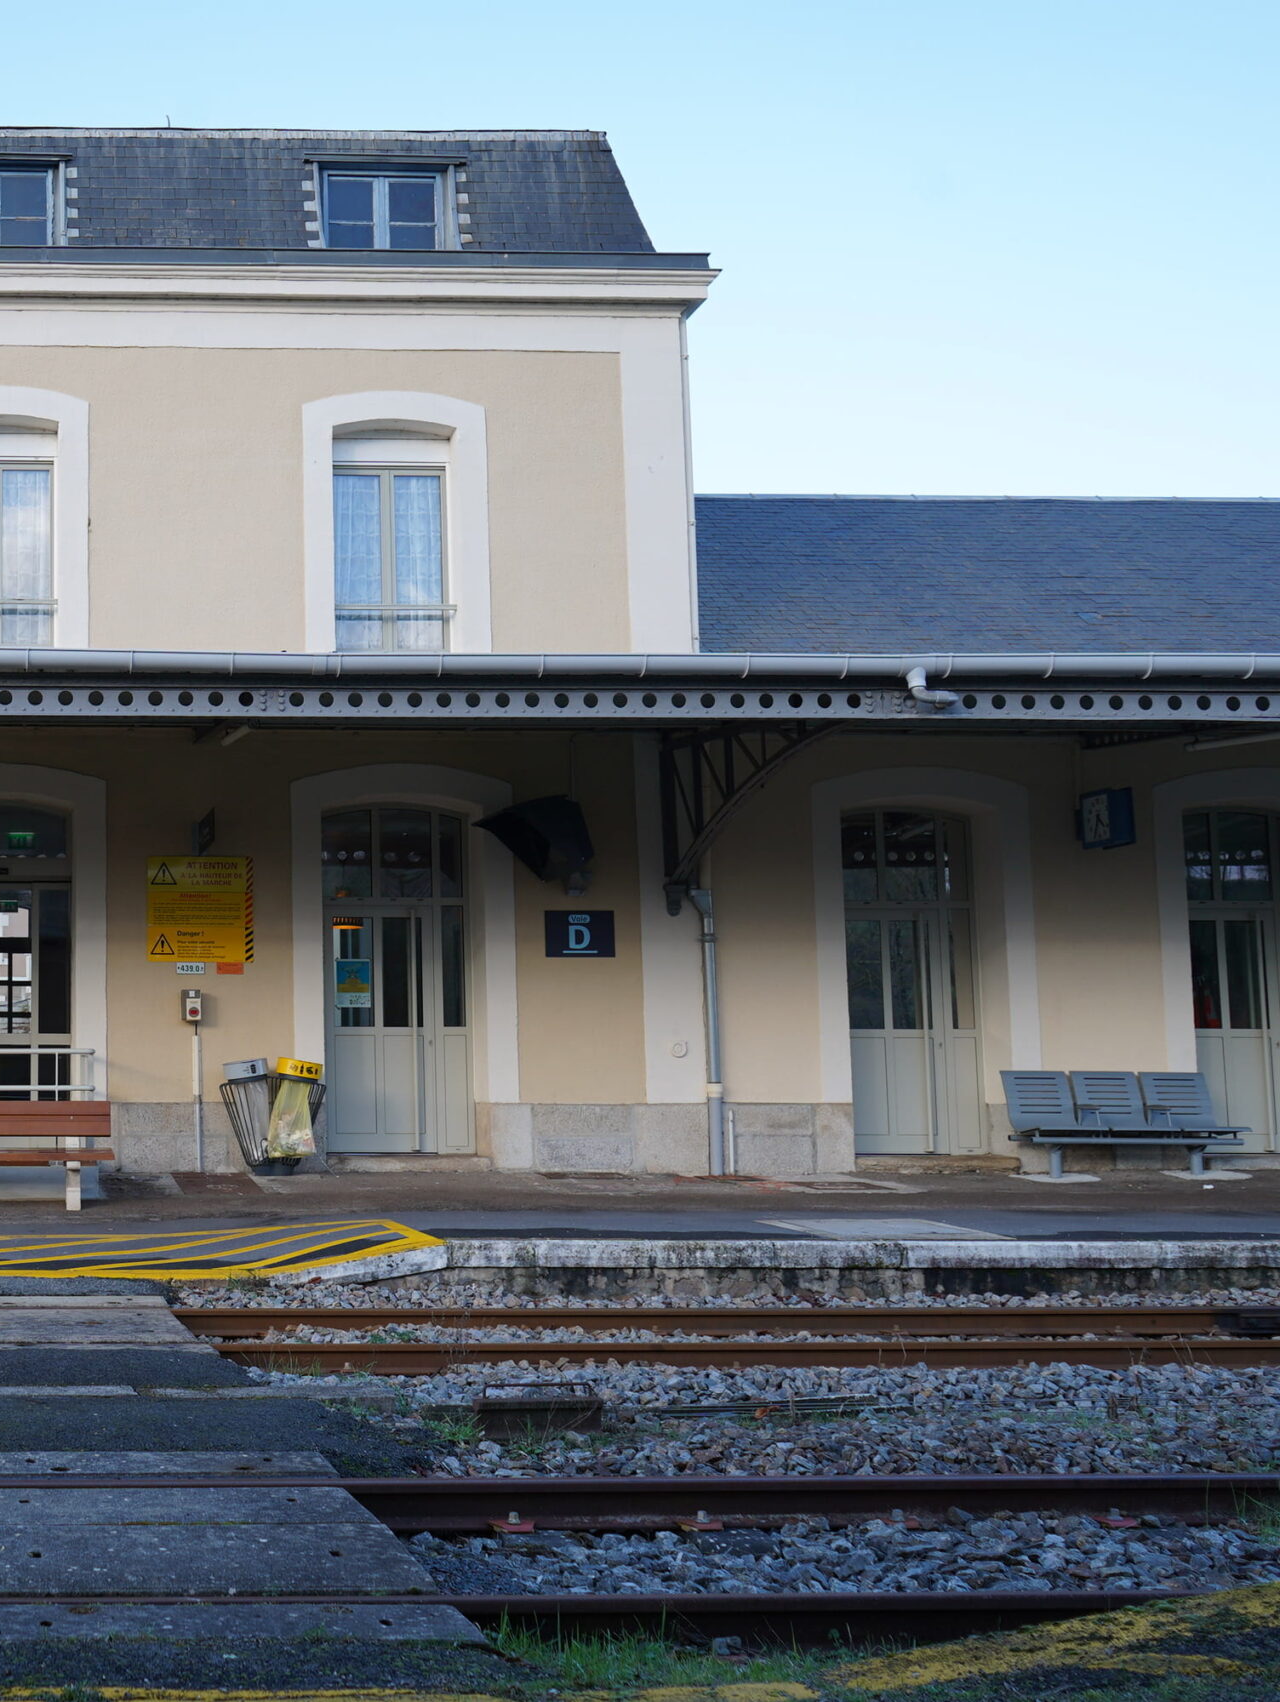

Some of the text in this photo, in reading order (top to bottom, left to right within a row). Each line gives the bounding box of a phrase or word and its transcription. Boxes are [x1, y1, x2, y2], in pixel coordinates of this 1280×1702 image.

[186, 861, 238, 870] ATTENTION
[176, 930, 200, 938] Danger
[568, 925, 591, 949] D
